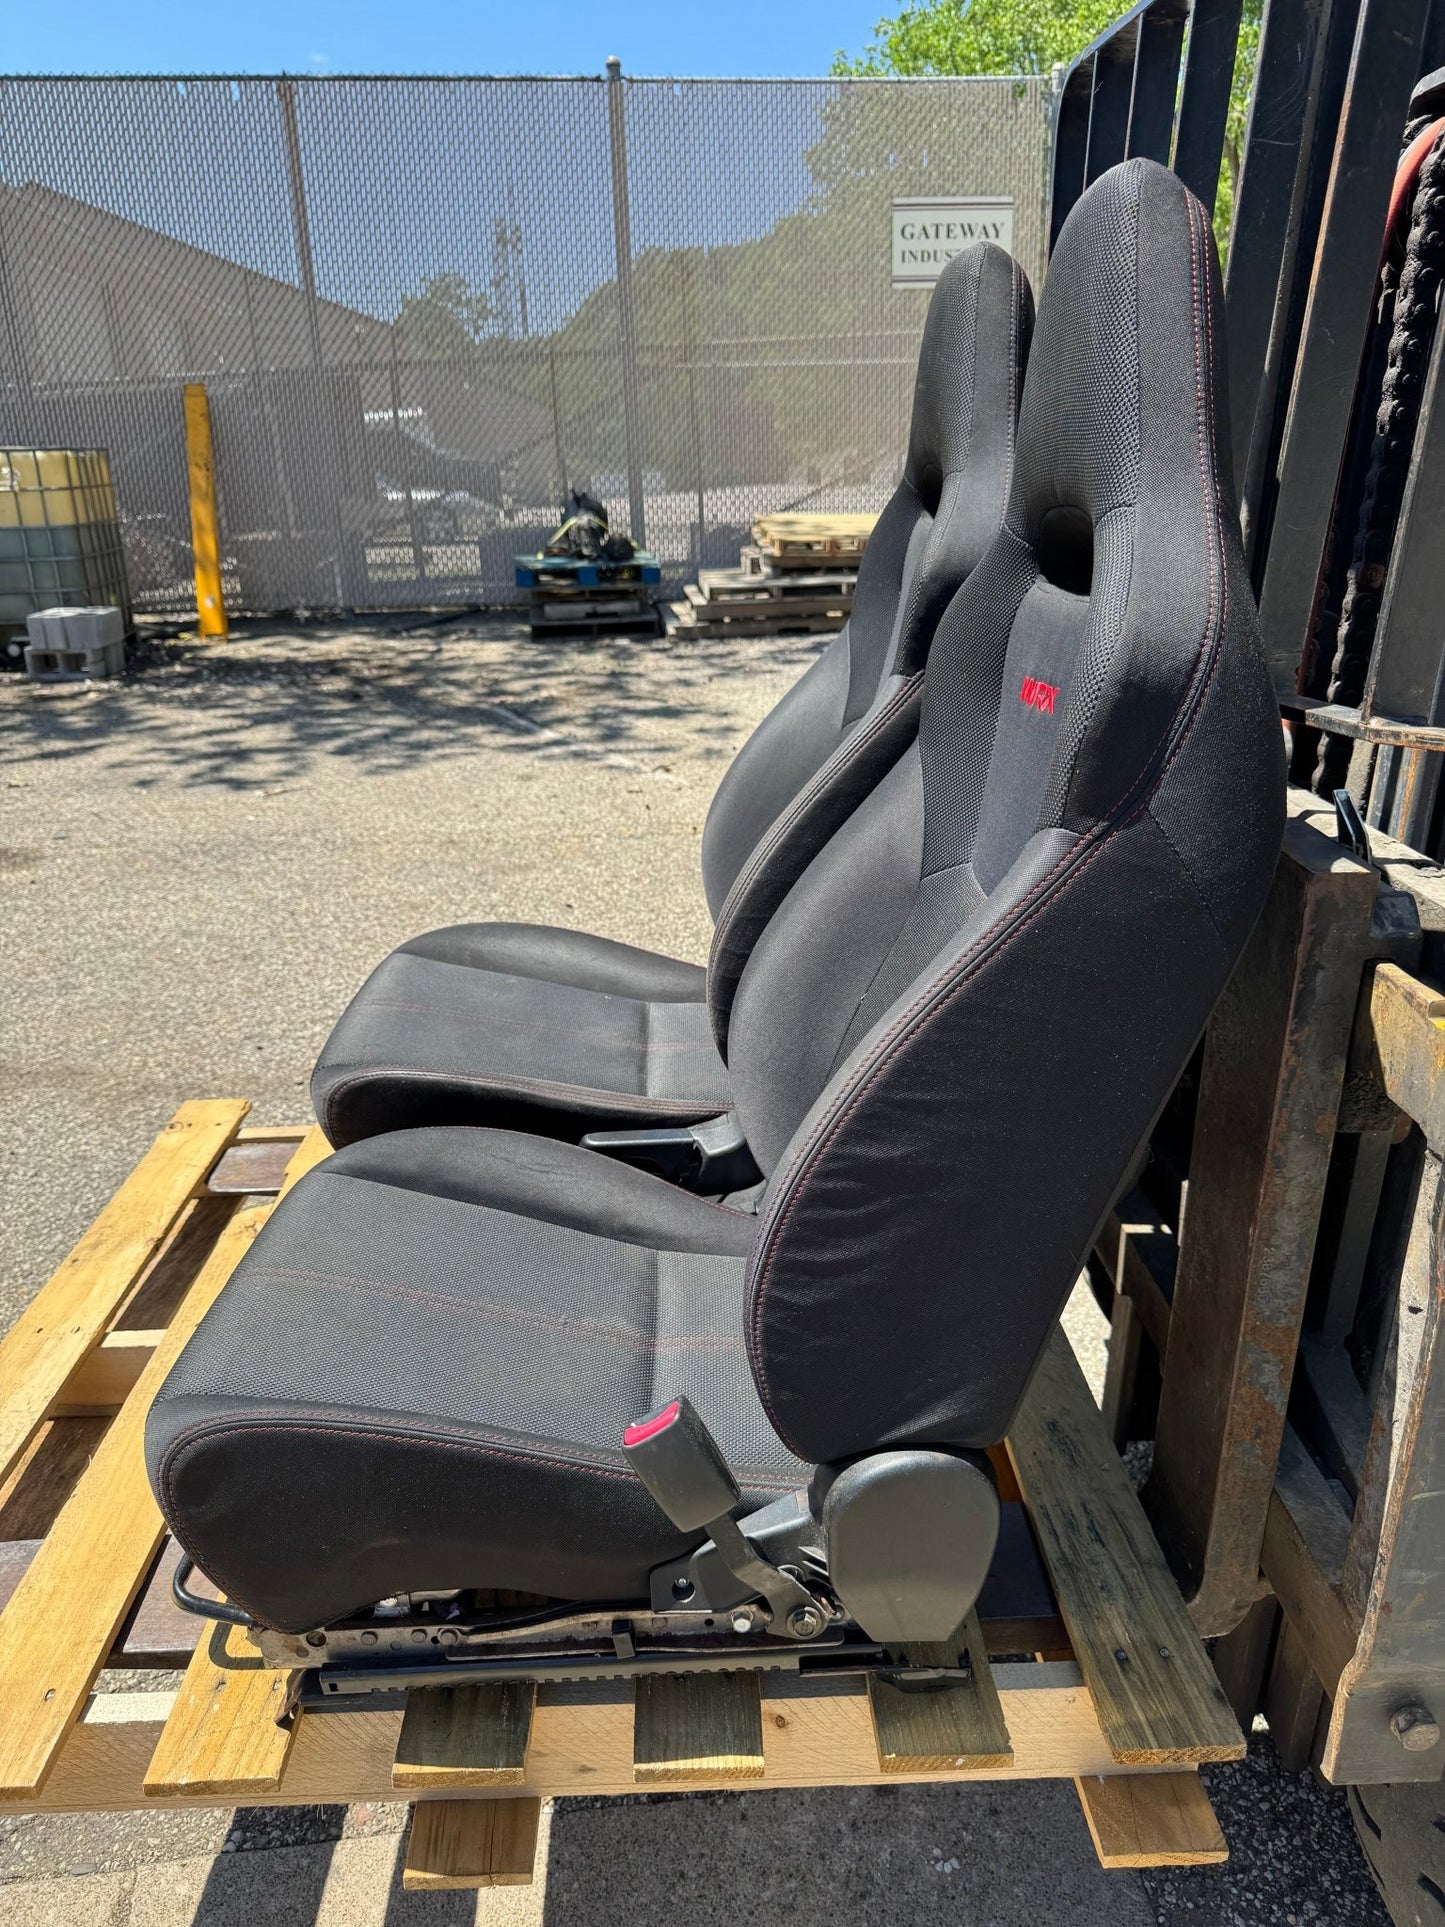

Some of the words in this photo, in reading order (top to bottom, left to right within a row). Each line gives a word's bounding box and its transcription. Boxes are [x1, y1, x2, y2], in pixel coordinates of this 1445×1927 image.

[901, 222, 1004, 240] GATEWAY
[901, 248, 961, 264] INDUS
[1020, 675, 1060, 714] WRX
